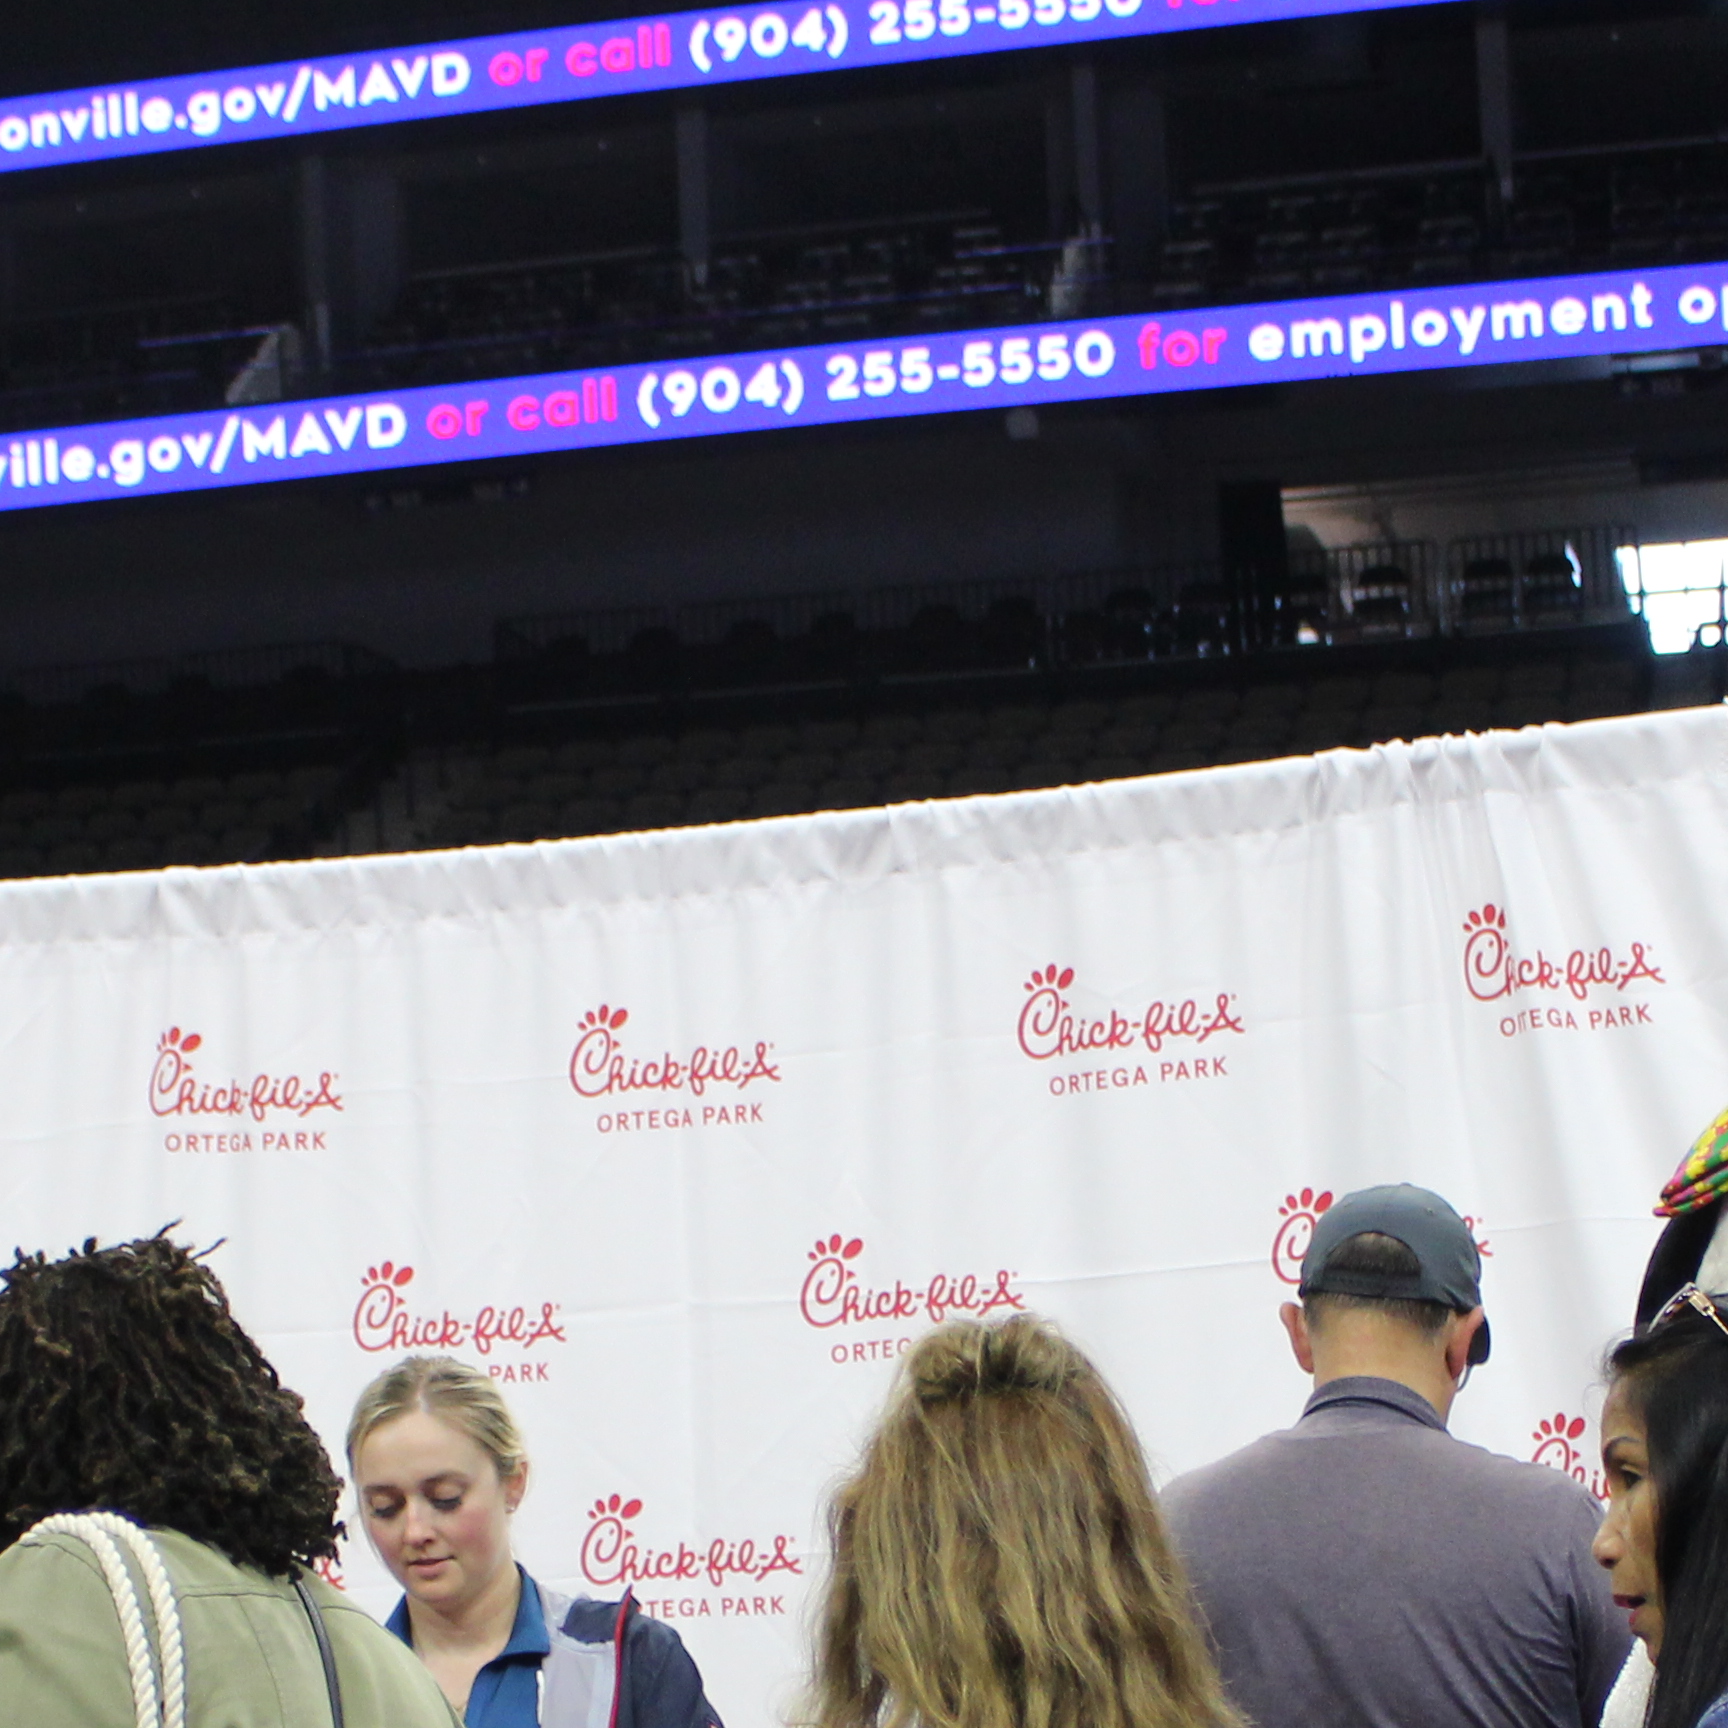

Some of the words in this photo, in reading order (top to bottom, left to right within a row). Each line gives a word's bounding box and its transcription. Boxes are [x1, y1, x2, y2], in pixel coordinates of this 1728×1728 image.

[487, 46, 551, 87] or
[564, 22, 673, 78] call
[687, 4, 850, 72] (904)
[425, 399, 491, 441] or
[504, 375, 620, 432] call
[635, 358, 806, 428] (904)
[825, 330, 1117, 401] 255-5550
[1136, 321, 1229, 371] for
[1247, 283, 1655, 364] employment
[1017, 986, 1245, 1059] Chick-fil-A
[1589, 1003, 1652, 1030] PARK
[148, 1050, 344, 1121] Chick-fil-A
[569, 1028, 782, 1100] Chick-fil-A
[1049, 1065, 1149, 1095] ORTEGA
[1161, 1055, 1228, 1081] PARK
[165, 1133, 254, 1153] ORTEGA
[262, 1131, 326, 1151] PARK
[597, 1108, 694, 1133] ORTEGA
[703, 1102, 763, 1125] PARK
[353, 1283, 567, 1355] Chick-fil-A
[800, 1257, 1028, 1329] Chick-fil-A
[489, 1362, 549, 1383] PARK
[580, 1516, 804, 1586] Chick-fil-A
[647, 1597, 711, 1619] TEGA
[721, 1595, 786, 1617] PARK
